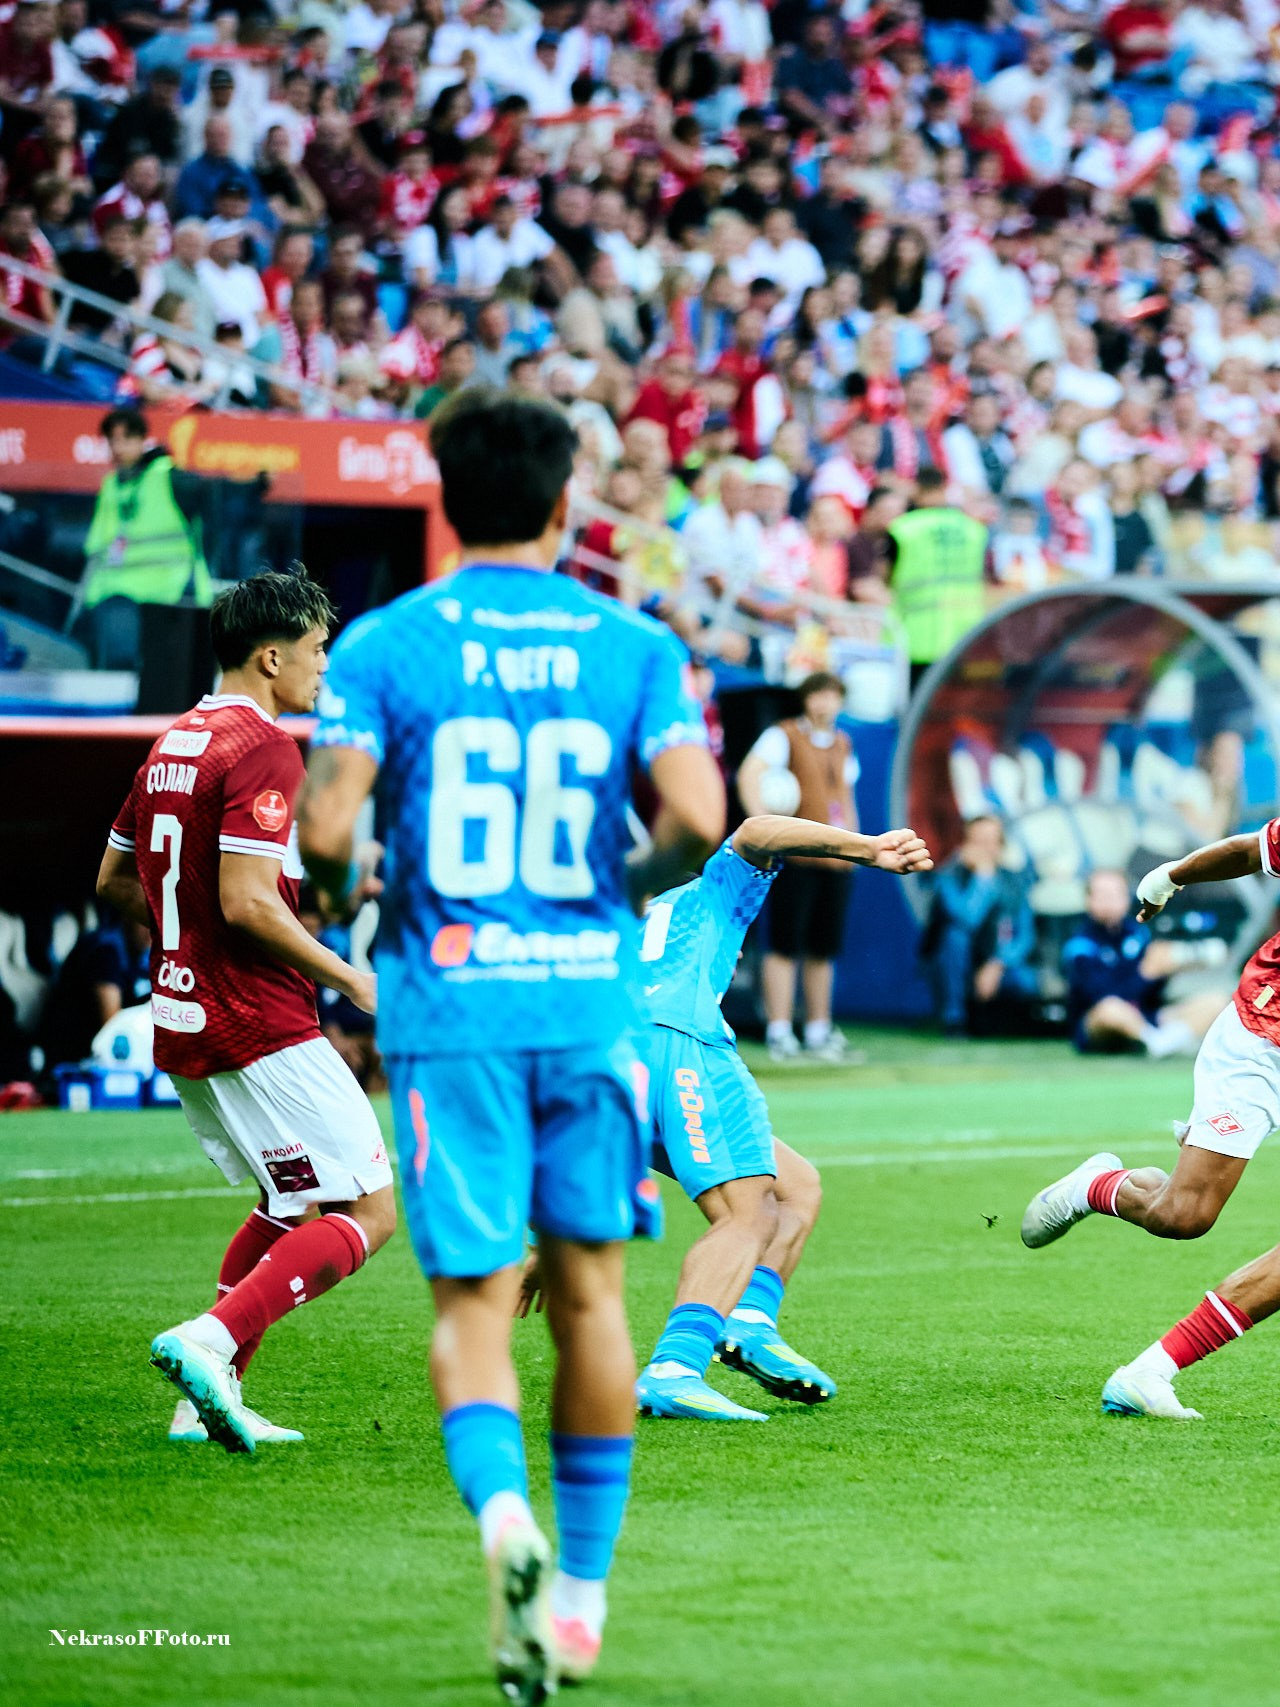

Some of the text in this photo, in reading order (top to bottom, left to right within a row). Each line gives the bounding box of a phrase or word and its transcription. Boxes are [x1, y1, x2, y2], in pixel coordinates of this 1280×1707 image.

[428, 717, 612, 899] 66
[150, 814, 183, 950] 7
[261, 1142, 304, 1159] ЛУКОЙЛ
